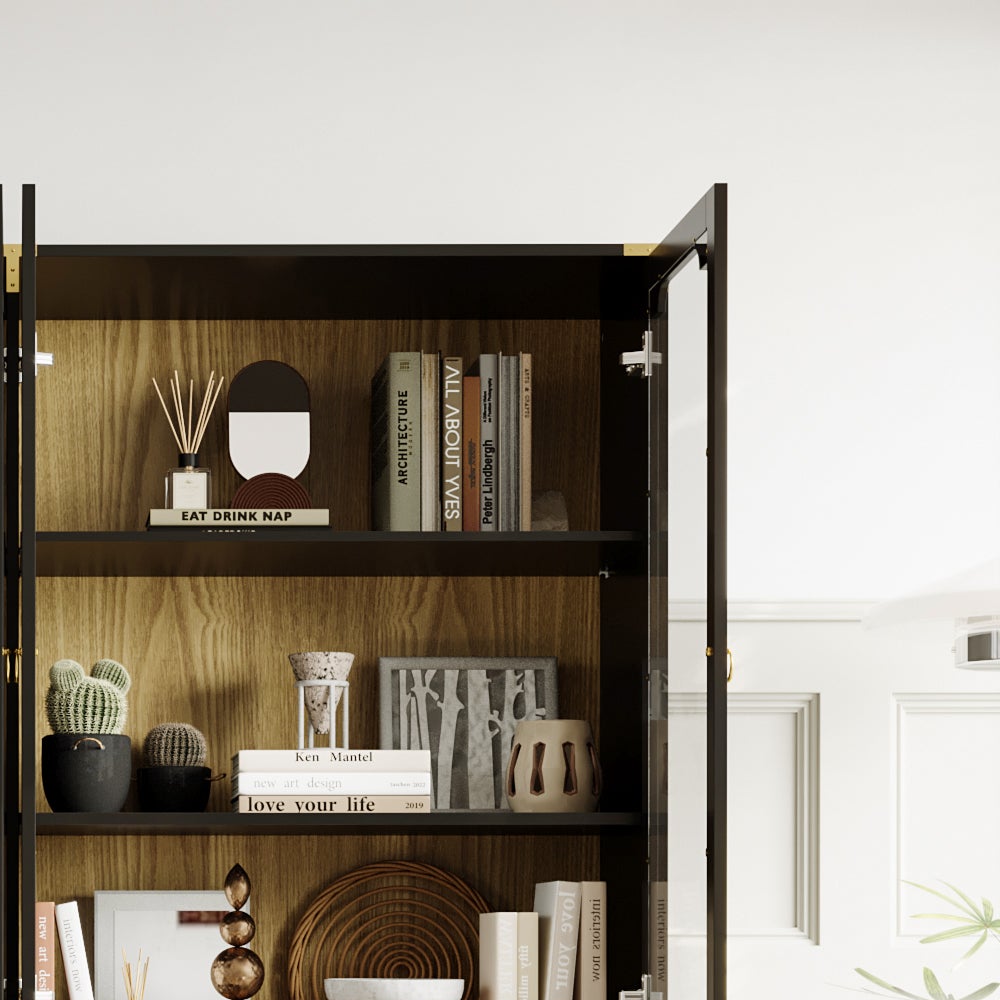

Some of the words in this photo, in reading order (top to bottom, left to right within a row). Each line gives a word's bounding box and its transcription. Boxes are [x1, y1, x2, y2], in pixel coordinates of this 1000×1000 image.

[445, 365, 461, 409] ALL
[398, 390, 408, 485] ARCHITECTURE
[445, 413, 461, 469] ABOUT
[482, 439, 496, 494] Lindbergh
[445, 475, 461, 520] YVES
[482, 495, 494, 525] Peter
[181, 511, 208, 522] EAT
[213, 511, 257, 522] DRINK
[262, 511, 293, 522] NAP
[295, 752, 320, 762] Ken
[330, 752, 374, 762] Mantel
[253, 779, 277, 788] new
[283, 778, 299, 788] art
[307, 777, 342, 791] design
[247, 796, 285, 812] love
[295, 800, 337, 813] your
[346, 796, 376, 812] life
[38, 915, 47, 940] new
[38, 946, 49, 962] art
[63, 919, 78, 966] interiors
[71, 969, 83, 993] now
[38, 968, 51, 992] desi
